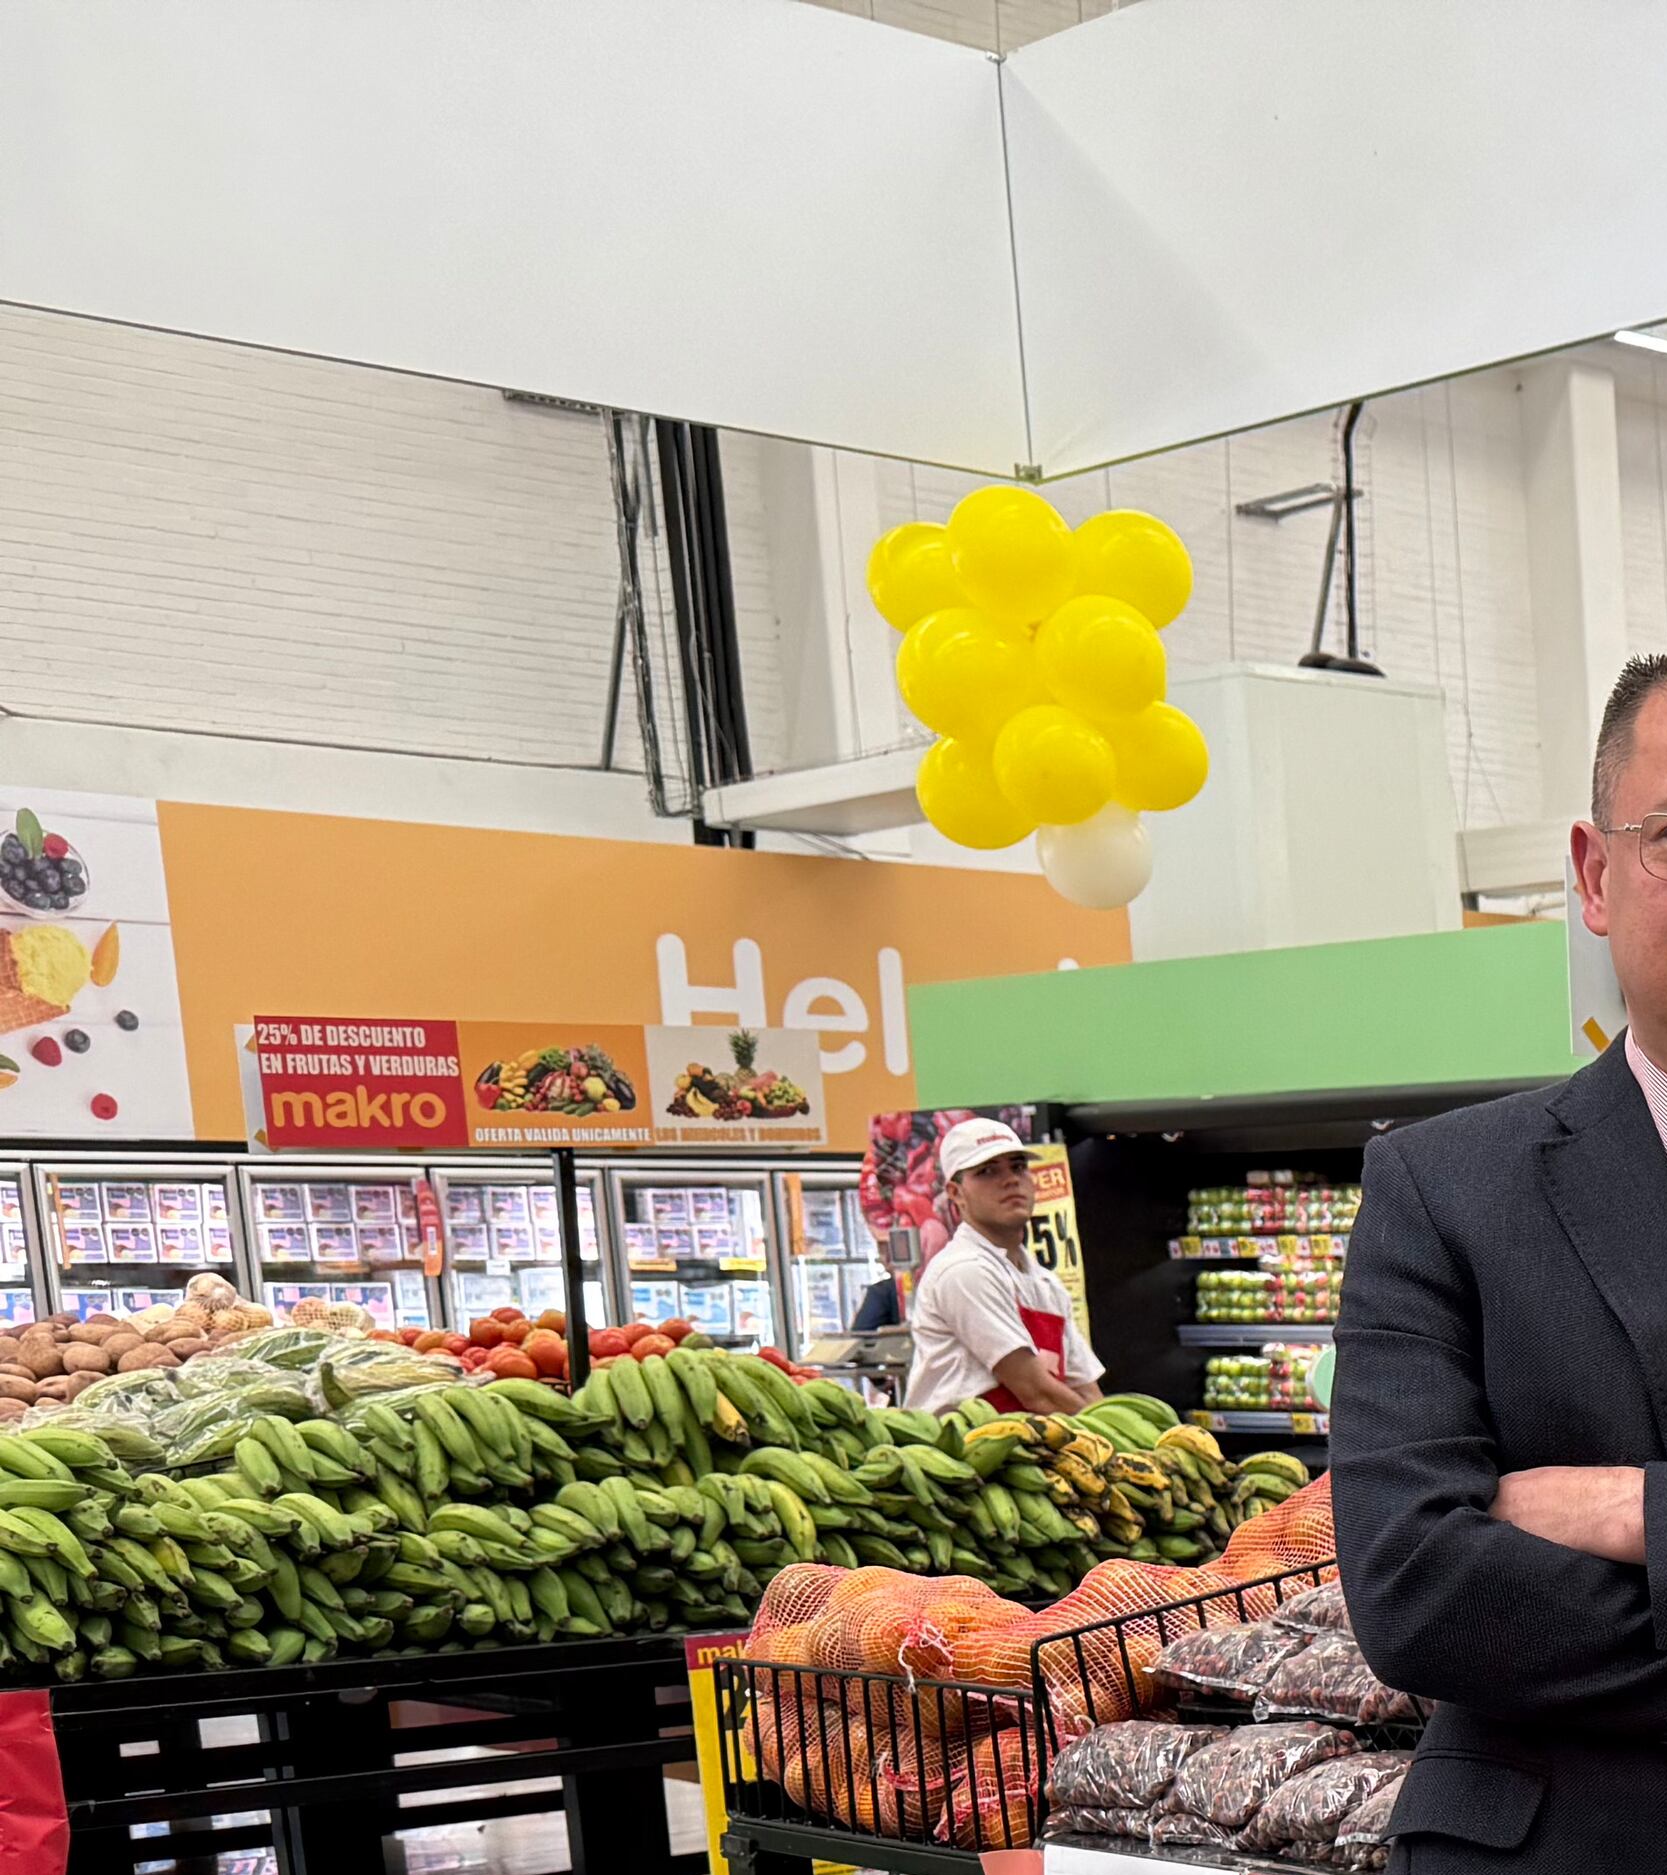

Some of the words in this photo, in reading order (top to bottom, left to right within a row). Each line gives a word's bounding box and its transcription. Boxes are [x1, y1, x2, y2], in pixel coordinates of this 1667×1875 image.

[656, 933, 911, 1076] Hel
[257, 1024, 297, 1045] 25%
[300, 1025, 323, 1046] DE
[326, 1026, 426, 1047] DESCUENTO
[260, 1053, 283, 1074] EN
[286, 1054, 352, 1075] FRUTAS
[355, 1055, 365, 1075] Y
[369, 1056, 460, 1077] VERDURAS
[271, 1085, 447, 1129] makro
[475, 1128, 522, 1141] OFERTA
[524, 1128, 569, 1141] VALIDA
[571, 1128, 650, 1141] UNICAMENTE
[1023, 1210, 1077, 1271] 5%
[697, 1639, 746, 1664] mak
